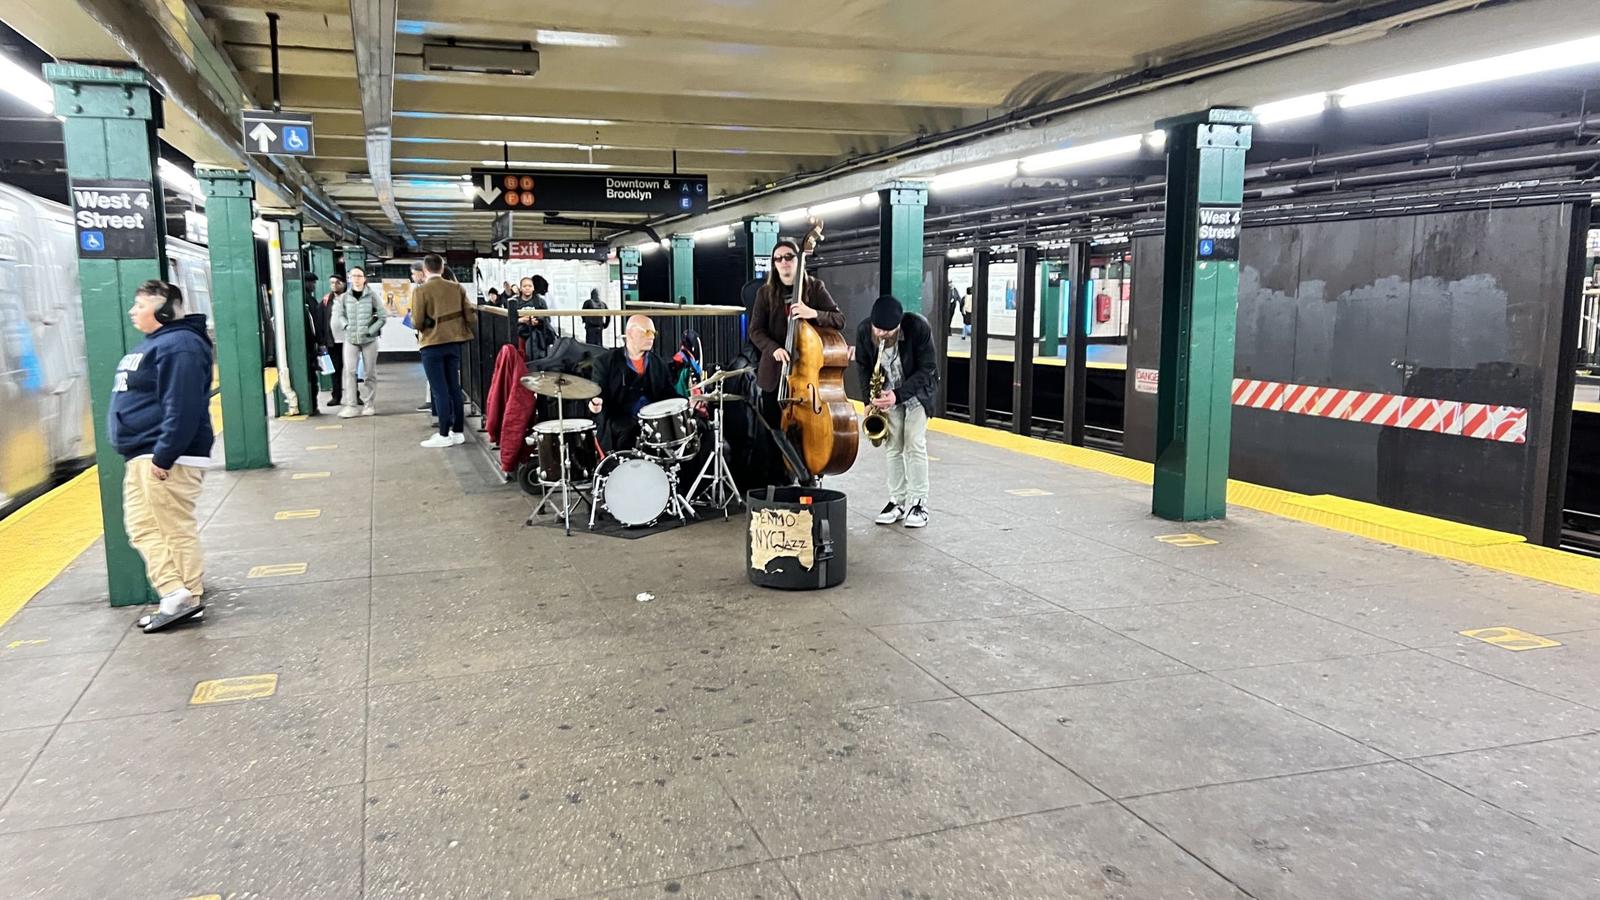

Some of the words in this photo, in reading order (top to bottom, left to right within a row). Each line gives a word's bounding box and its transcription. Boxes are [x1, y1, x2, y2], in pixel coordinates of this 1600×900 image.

[606, 178, 660, 189] Downtown
[663, 180, 671, 189] &
[696, 184, 703, 192] C
[74, 191, 131, 209] West
[134, 193, 149, 209] 4
[606, 188, 652, 201] Brooklyn
[77, 210, 144, 229] Street
[1200, 210, 1231, 224] West
[1231, 211, 1240, 224] 4
[1200, 225, 1236, 239] Street
[508, 242, 540, 256] Exit
[1136, 370, 1158, 381] DANGE
